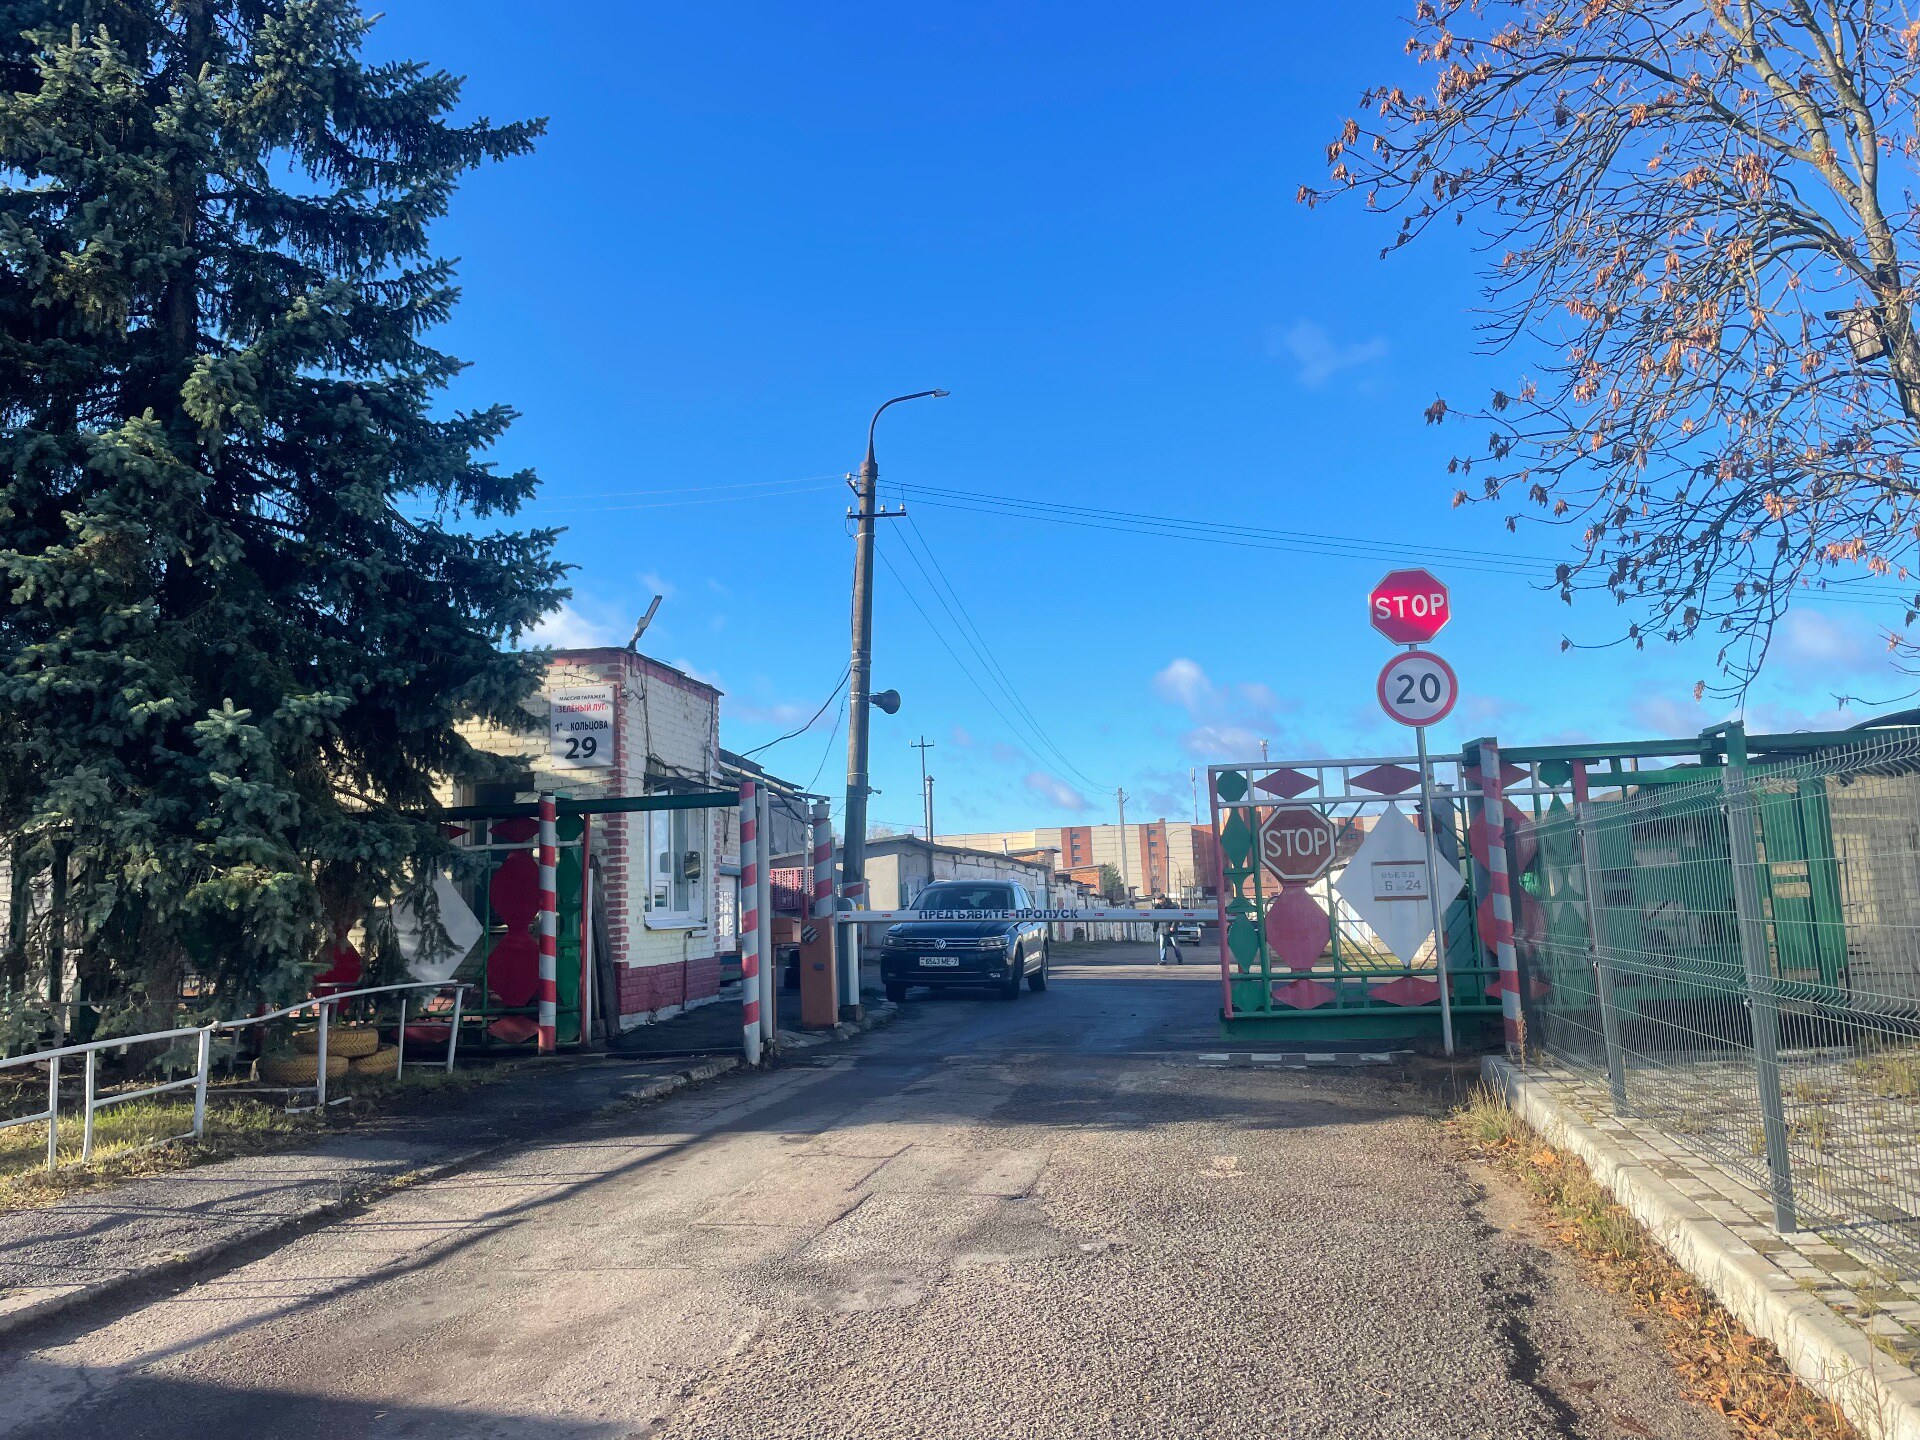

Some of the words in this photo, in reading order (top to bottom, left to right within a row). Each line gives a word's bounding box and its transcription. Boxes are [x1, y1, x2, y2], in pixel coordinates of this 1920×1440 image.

[1375, 593, 1445, 620] STOP
[1396, 673, 1441, 704] 20
[570, 720, 609, 732] КОЛЬЦОВА
[565, 736, 597, 760] 29
[1265, 827, 1328, 857] STOP
[1405, 879, 1421, 891] 24
[919, 909, 1010, 920] ПРЕДЪЯВИТЕ
[1015, 909, 1079, 919] ПРОПУСК
